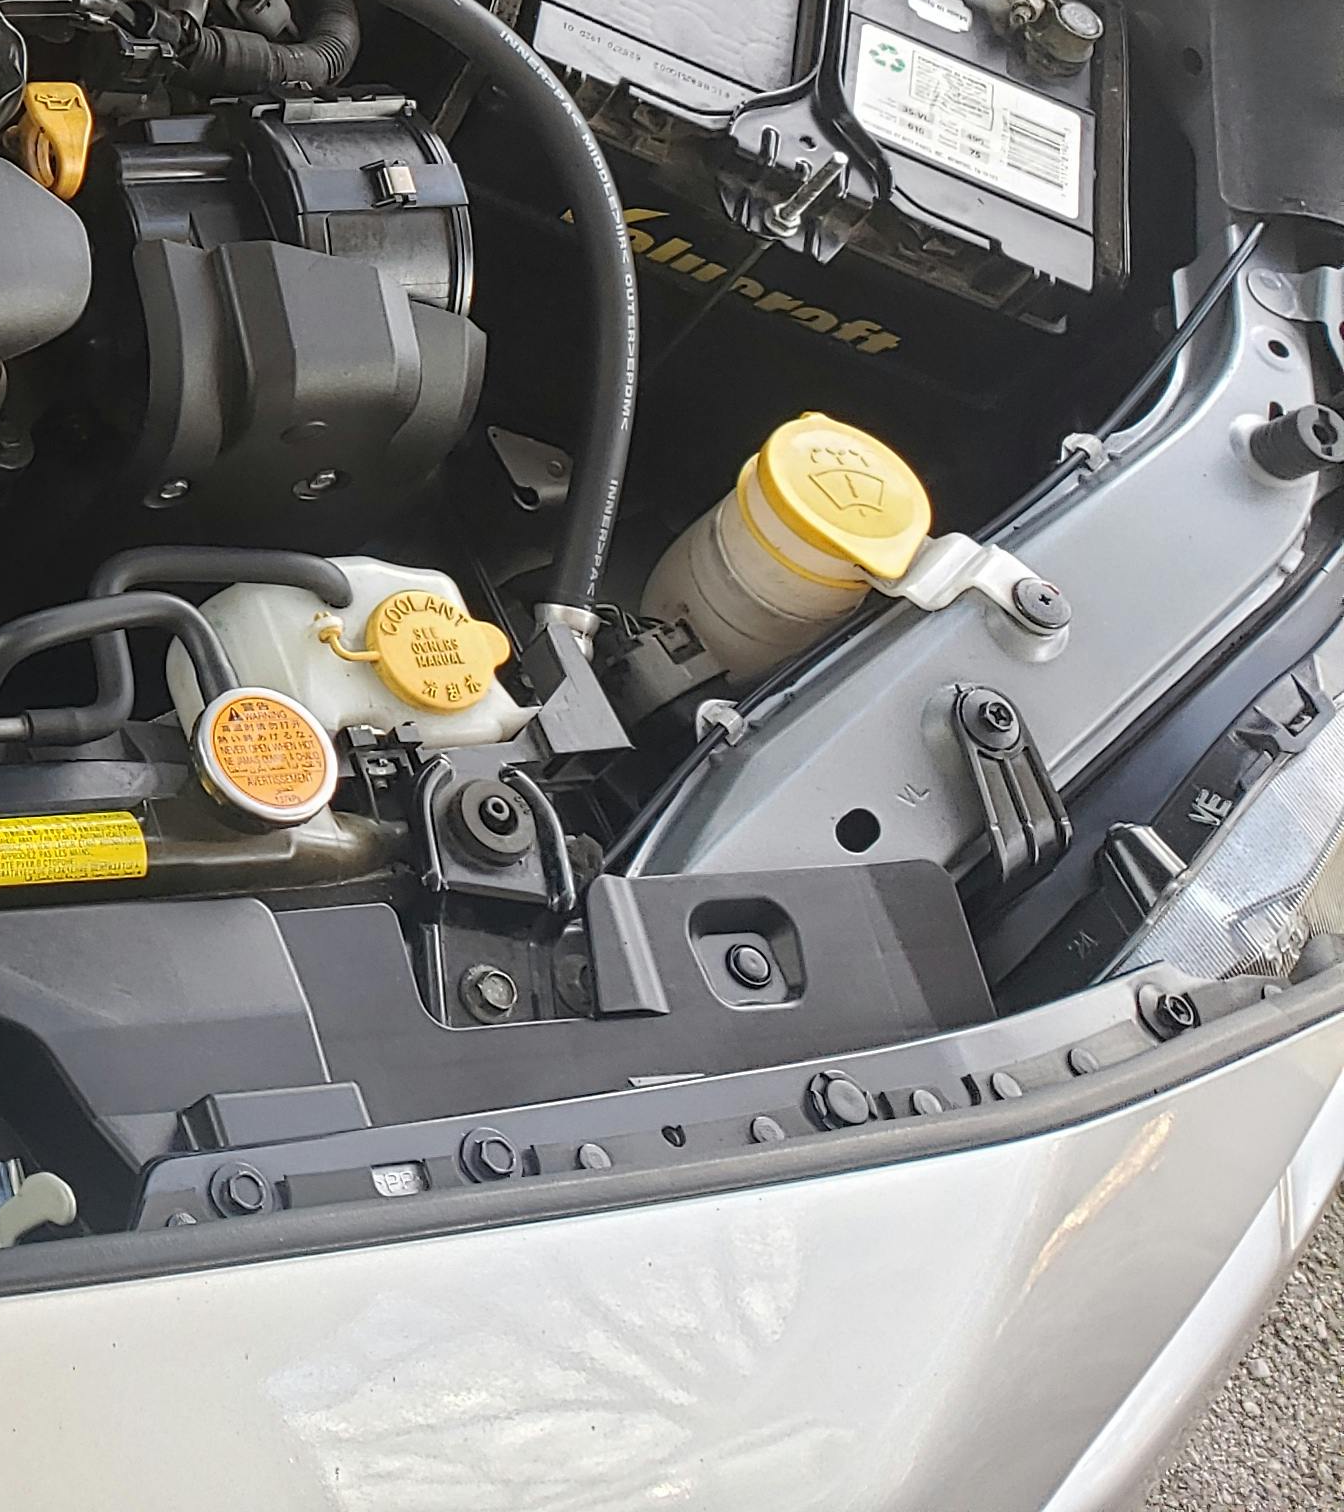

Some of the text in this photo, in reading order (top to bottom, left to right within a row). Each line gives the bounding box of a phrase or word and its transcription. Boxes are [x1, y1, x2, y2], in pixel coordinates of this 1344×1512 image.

[969, 148, 981, 159] 75
[620, 273, 636, 431] OUTER>EPDM<
[380, 594, 469, 637] COOLANT
[413, 626, 438, 640] SEE
[410, 638, 459, 655] OWNERS
[415, 651, 465, 669] MANUAL
[244, 710, 288, 721] WARNING
[220, 739, 315, 756] NEVER OPEN WHEN HOT
[247, 771, 313, 787] AVERTISSEMENT
